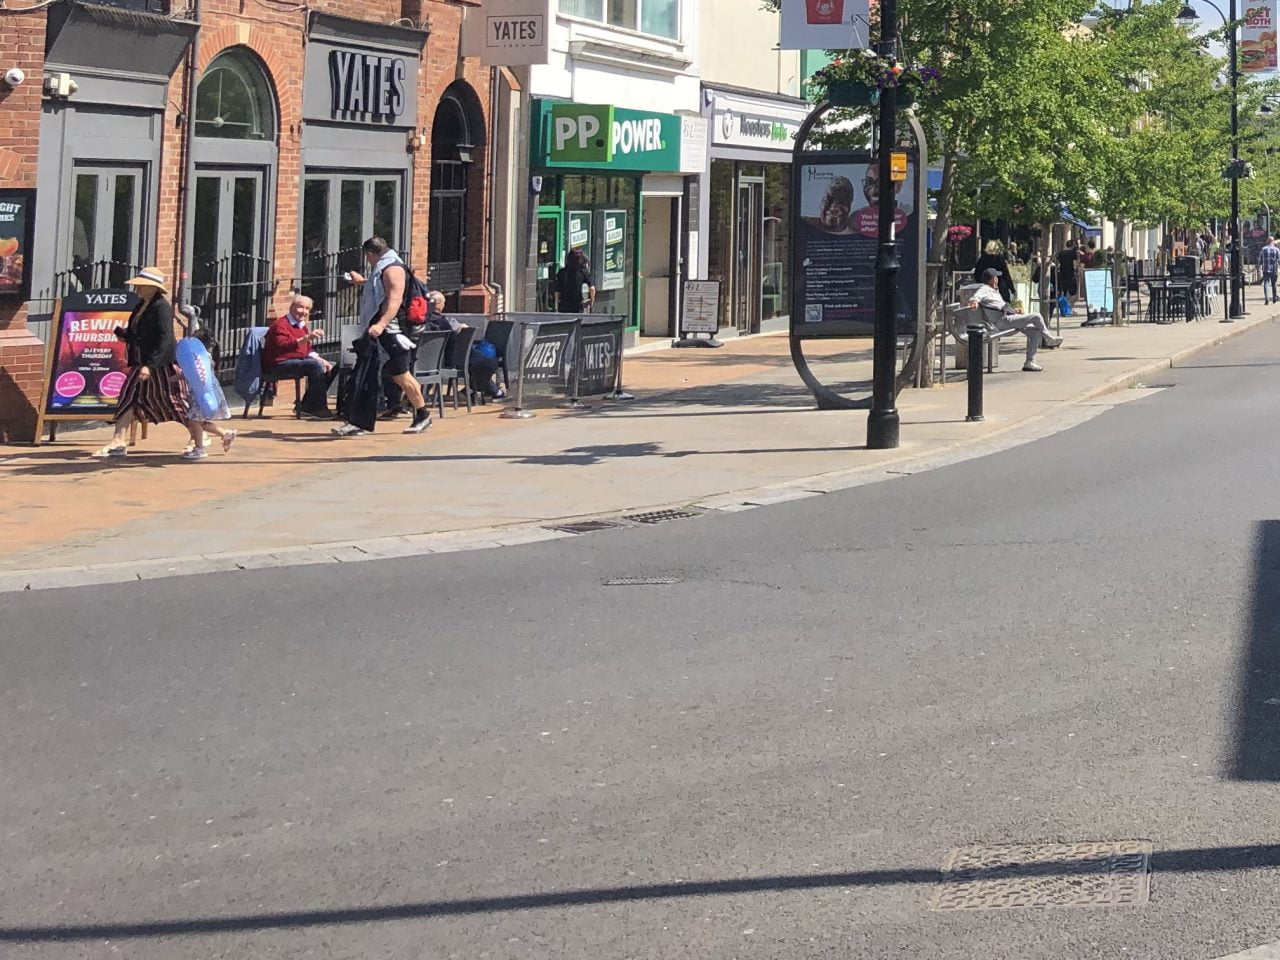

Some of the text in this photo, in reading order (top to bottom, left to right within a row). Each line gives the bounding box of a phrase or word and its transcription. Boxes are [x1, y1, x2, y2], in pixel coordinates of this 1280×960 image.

[494, 20, 537, 40] YATES
[333, 50, 406, 117] YATES
[85, 293, 127, 305] YATES
[70, 319, 129, 333] REWIN
[68, 332, 118, 343] THURSDA
[525, 341, 561, 369] YATES
[584, 342, 611, 370] YATES
